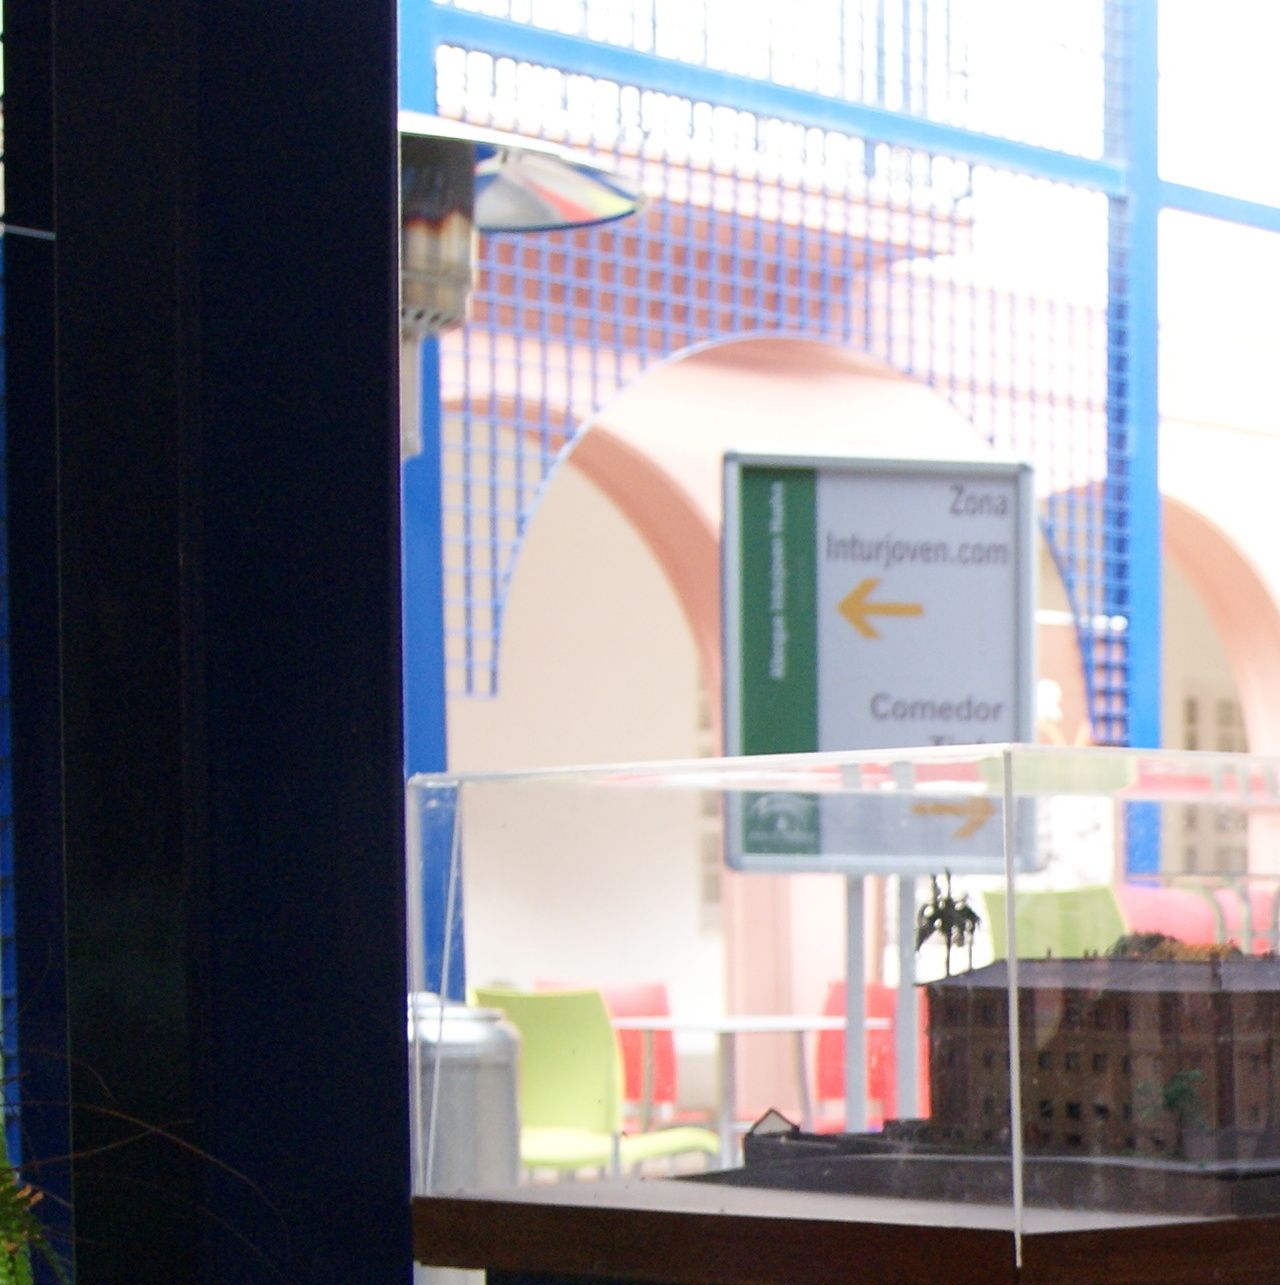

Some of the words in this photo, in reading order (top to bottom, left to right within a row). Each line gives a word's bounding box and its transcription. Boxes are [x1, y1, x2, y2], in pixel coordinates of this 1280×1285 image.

[949, 484, 1009, 518] Zona
[825, 533, 1009, 567] Inturjoven.com
[870, 692, 1003, 723] Comedor
